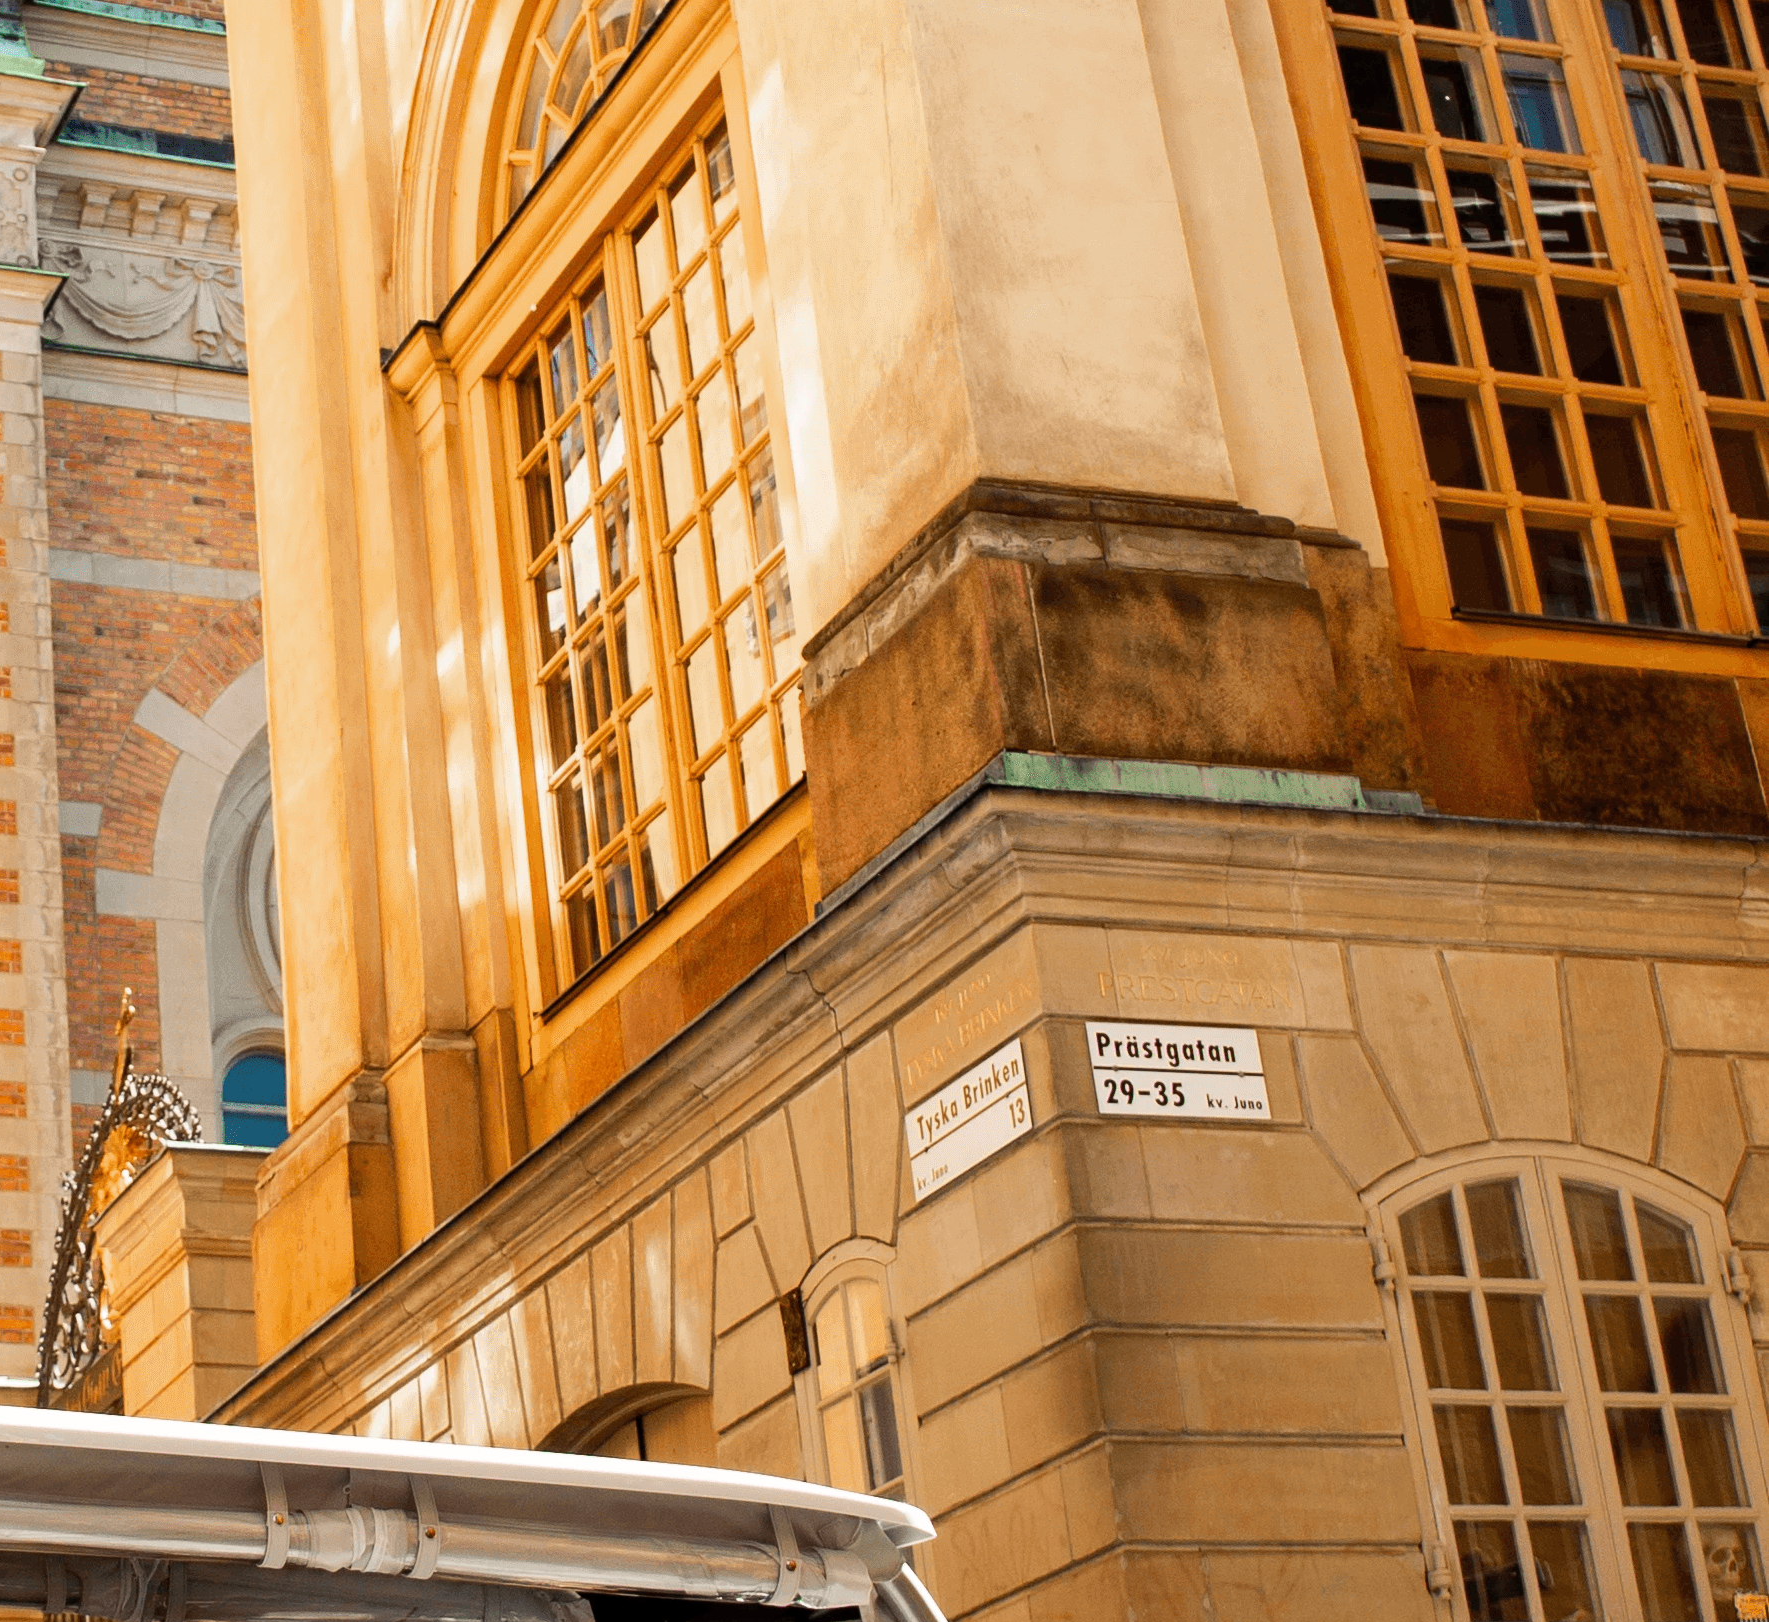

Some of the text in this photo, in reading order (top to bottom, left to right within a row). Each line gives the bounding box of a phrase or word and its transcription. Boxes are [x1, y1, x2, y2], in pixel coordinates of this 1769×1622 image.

[1096, 1032, 1236, 1067] Prästgatan
[917, 1058, 1019, 1142] Tyska Brinken
[1104, 1079, 1263, 1110] 29-35 kv. Juno
[1009, 1098, 1026, 1128] 13
[930, 1164, 949, 1186] Juno
